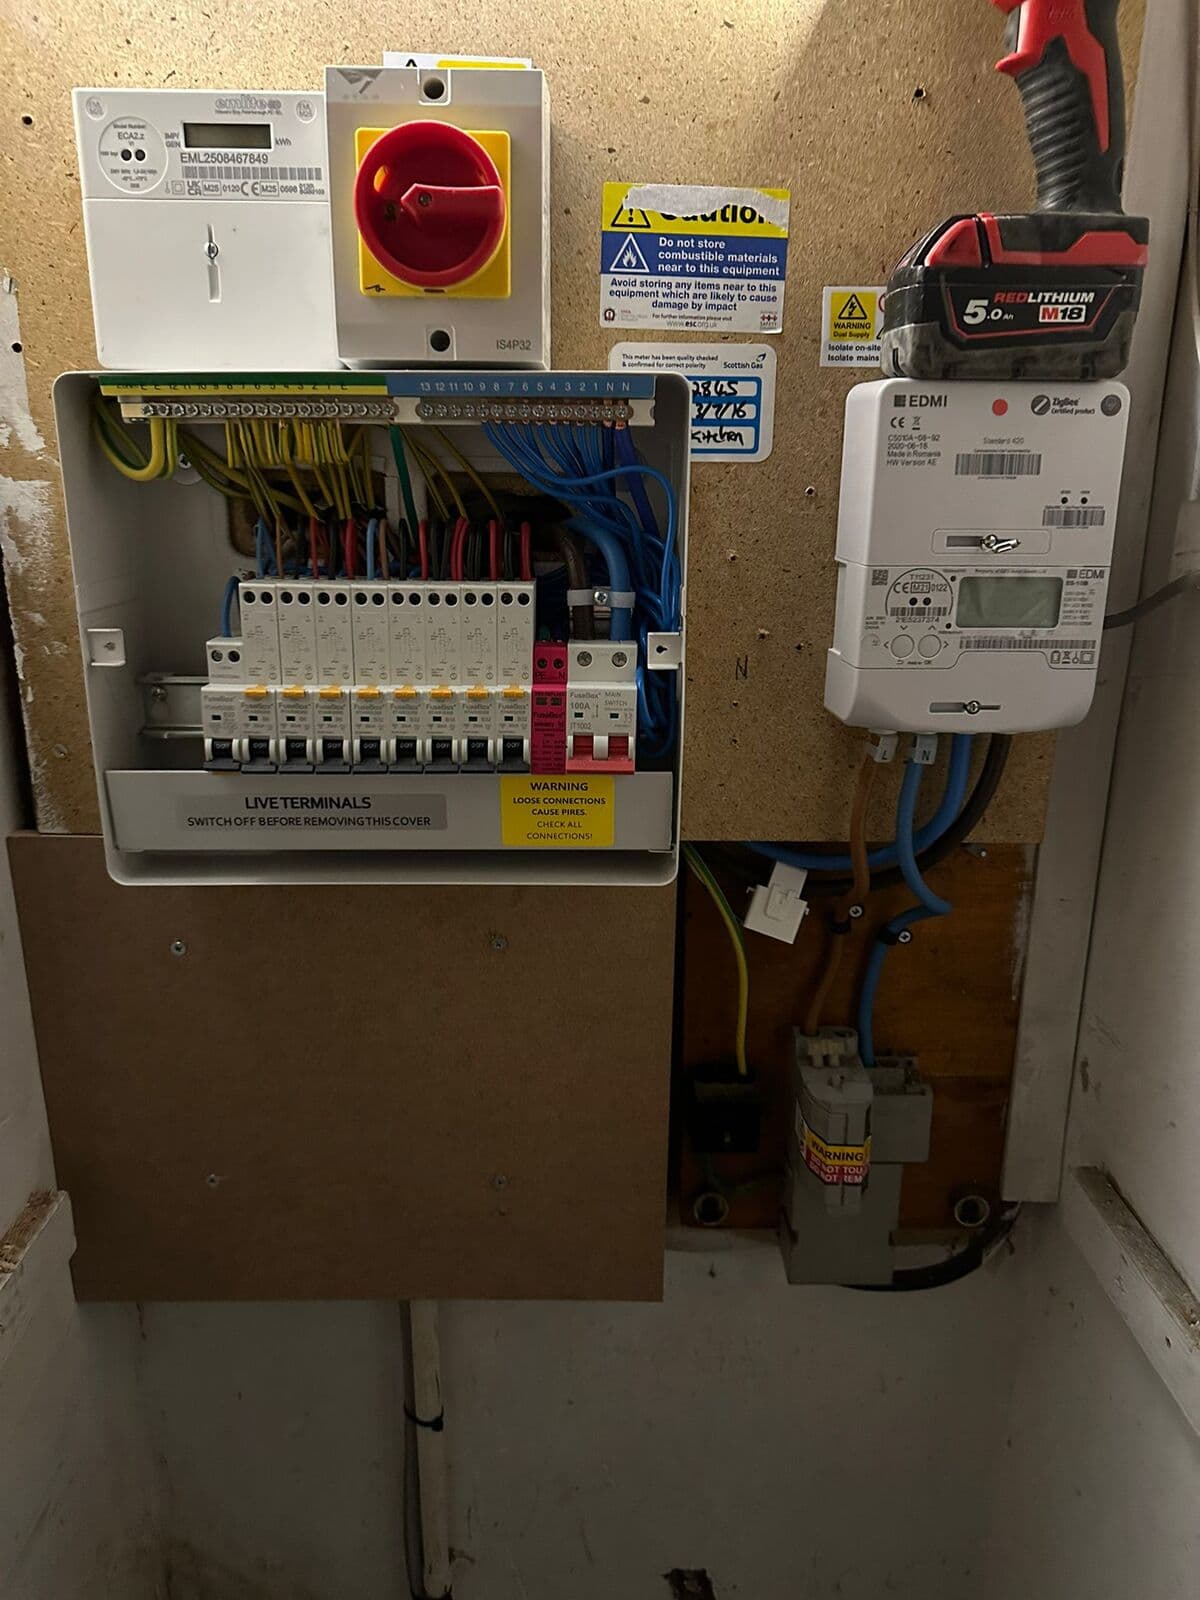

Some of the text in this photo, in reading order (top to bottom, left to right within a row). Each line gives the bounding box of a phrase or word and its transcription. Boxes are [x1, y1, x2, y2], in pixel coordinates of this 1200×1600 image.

[276, 138, 291, 146] kWh
[180, 152, 268, 164] EML2508467849
[203, 183, 219, 192] M25
[222, 184, 240, 192] 0120
[659, 237, 725, 249] Do not store
[658, 250, 778, 264] combustible materials
[658, 263, 780, 276] near to this equipment
[610, 278, 777, 293] Avoid storing any items near to this
[609, 288, 778, 303] equipment which are likely to cause
[994, 292, 1095, 304] REDLITHIUM
[652, 300, 737, 312] damage by impact
[962, 299, 1003, 325] 5.0
[1040, 306, 1083, 321] M18
[833, 321, 871, 330] WARNING
[848, 331, 870, 339] Supply
[496, 339, 532, 350] IS4P32
[828, 343, 881, 352] Isolate on-site
[676, 354, 695, 362] quality
[828, 353, 880, 363] Isolate mains
[420, 382, 431, 391] 13
[435, 382, 446, 391] 12
[449, 382, 458, 391] 11
[463, 382, 473, 391] 10
[479, 382, 486, 391] 9
[493, 382, 500, 391] 8
[508, 382, 515, 391] 7
[522, 382, 529, 391] 6
[536, 382, 543, 391] 5
[549, 382, 556, 391] 4
[565, 382, 571, 391] 3
[578, 382, 585, 391] 2
[606, 382, 614, 391] N
[622, 382, 630, 391] N
[909, 395, 947, 407] EDMI
[1051, 407, 1074, 415] Certified
[983, 437, 1011, 445] Standard
[1079, 570, 1105, 579] EDMI
[570, 702, 591, 710] 100A
[882, 750, 888, 760] L
[922, 750, 930, 761] N
[530, 782, 589, 791] WARNING
[244, 796, 372, 810] LIVE TERMINALS
[543, 797, 606, 805] CONNECTIONS
[187, 816, 431, 826] SWITCH OFF BEFORE REMOVING THIS COVER
[566, 821, 583, 829] ALL
[526, 832, 593, 840] CONNECTIONS!
[811, 1140, 865, 1162] WARNING
[821, 1164, 839, 1173] NOT
[820, 1172, 837, 1183] NOT
